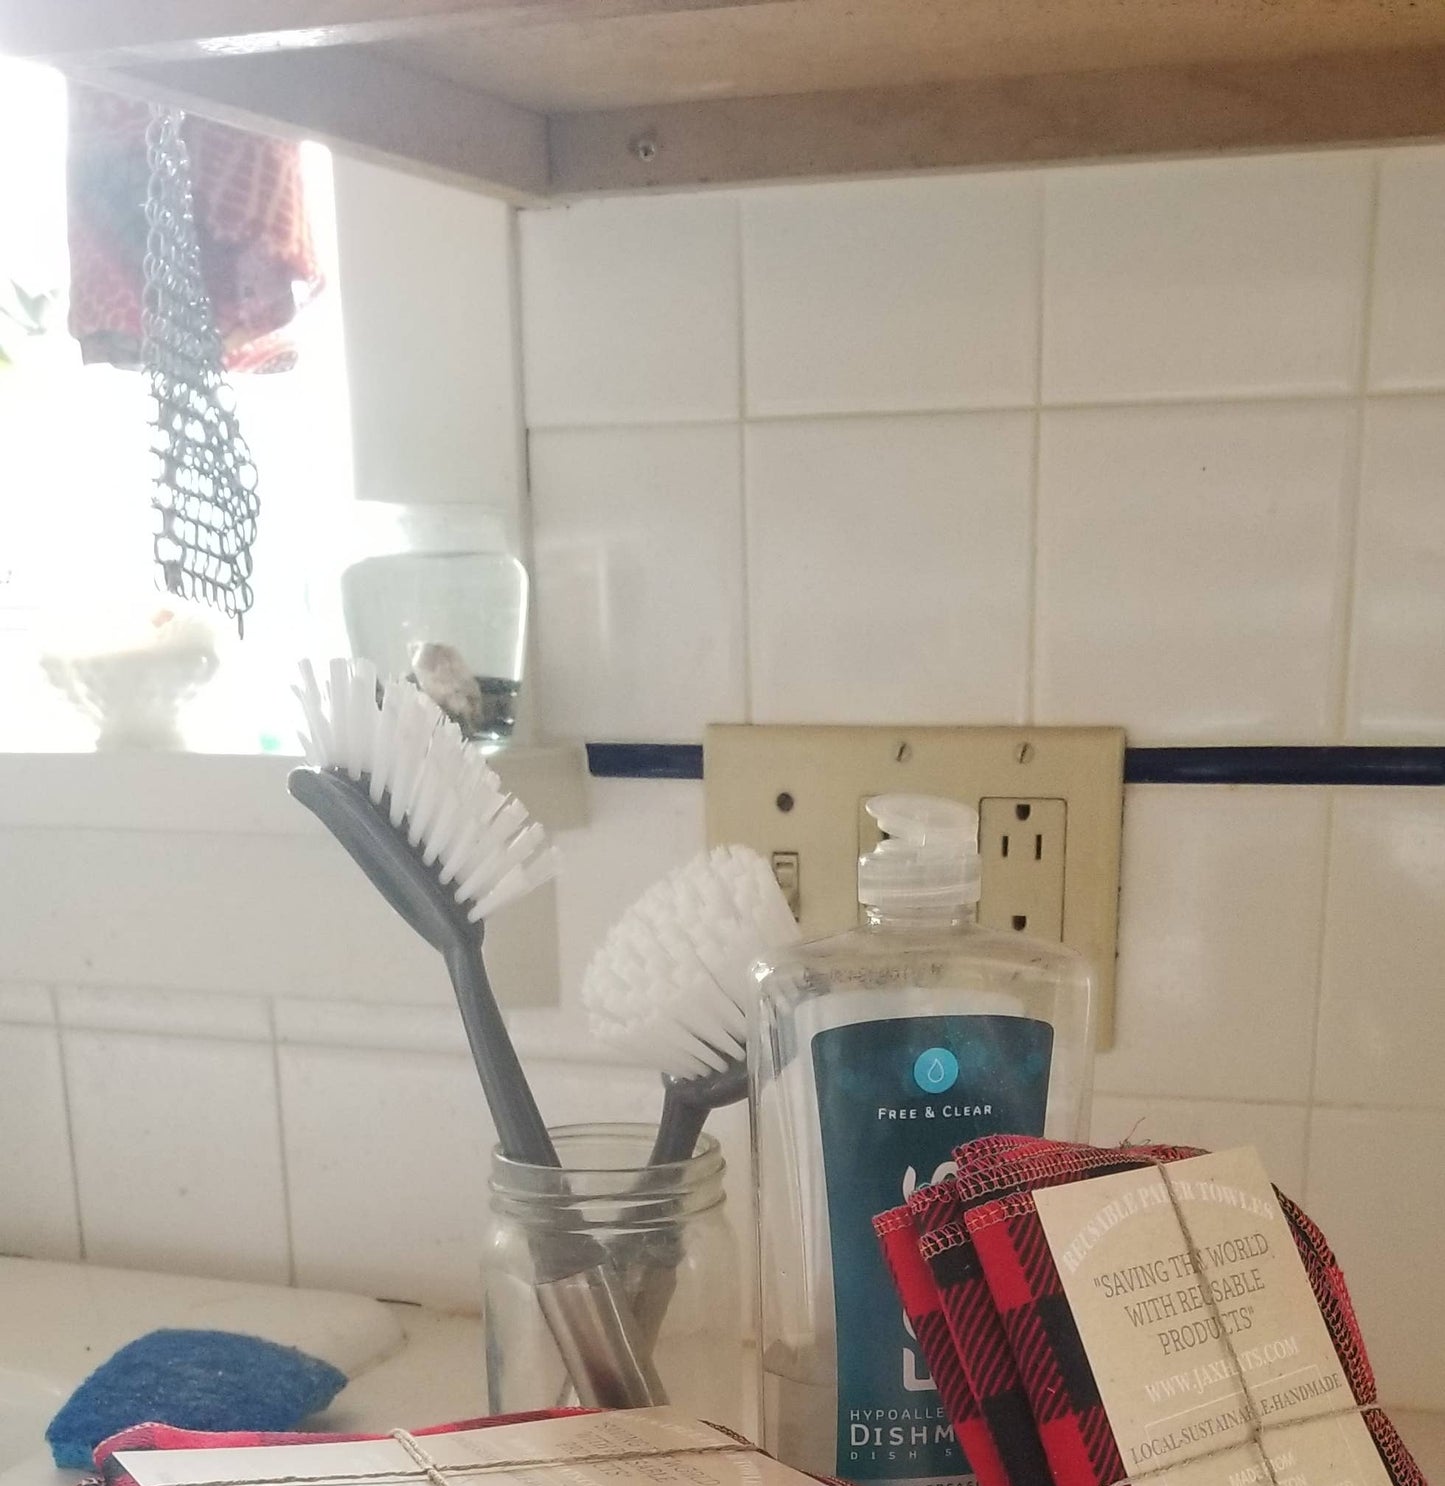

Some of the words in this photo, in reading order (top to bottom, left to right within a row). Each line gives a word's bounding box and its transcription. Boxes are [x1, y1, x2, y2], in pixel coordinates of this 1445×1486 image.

[878, 1107, 917, 1120] FREE
[925, 1106, 935, 1118] &
[942, 1105, 993, 1118] CLEAR
[1063, 1192, 1138, 1274] REUSABLE
[1093, 1259, 1170, 1298] "SAVING
[1204, 1233, 1269, 1267] WORLD
[1124, 1293, 1178, 1328] WITH
[1145, 1336, 1299, 1403] WWW.JAXHTS.COM
[850, 1407, 945, 1421] HYPOALLE
[850, 1423, 955, 1446] DISHM
[851, 1451, 917, 1461] DISH
